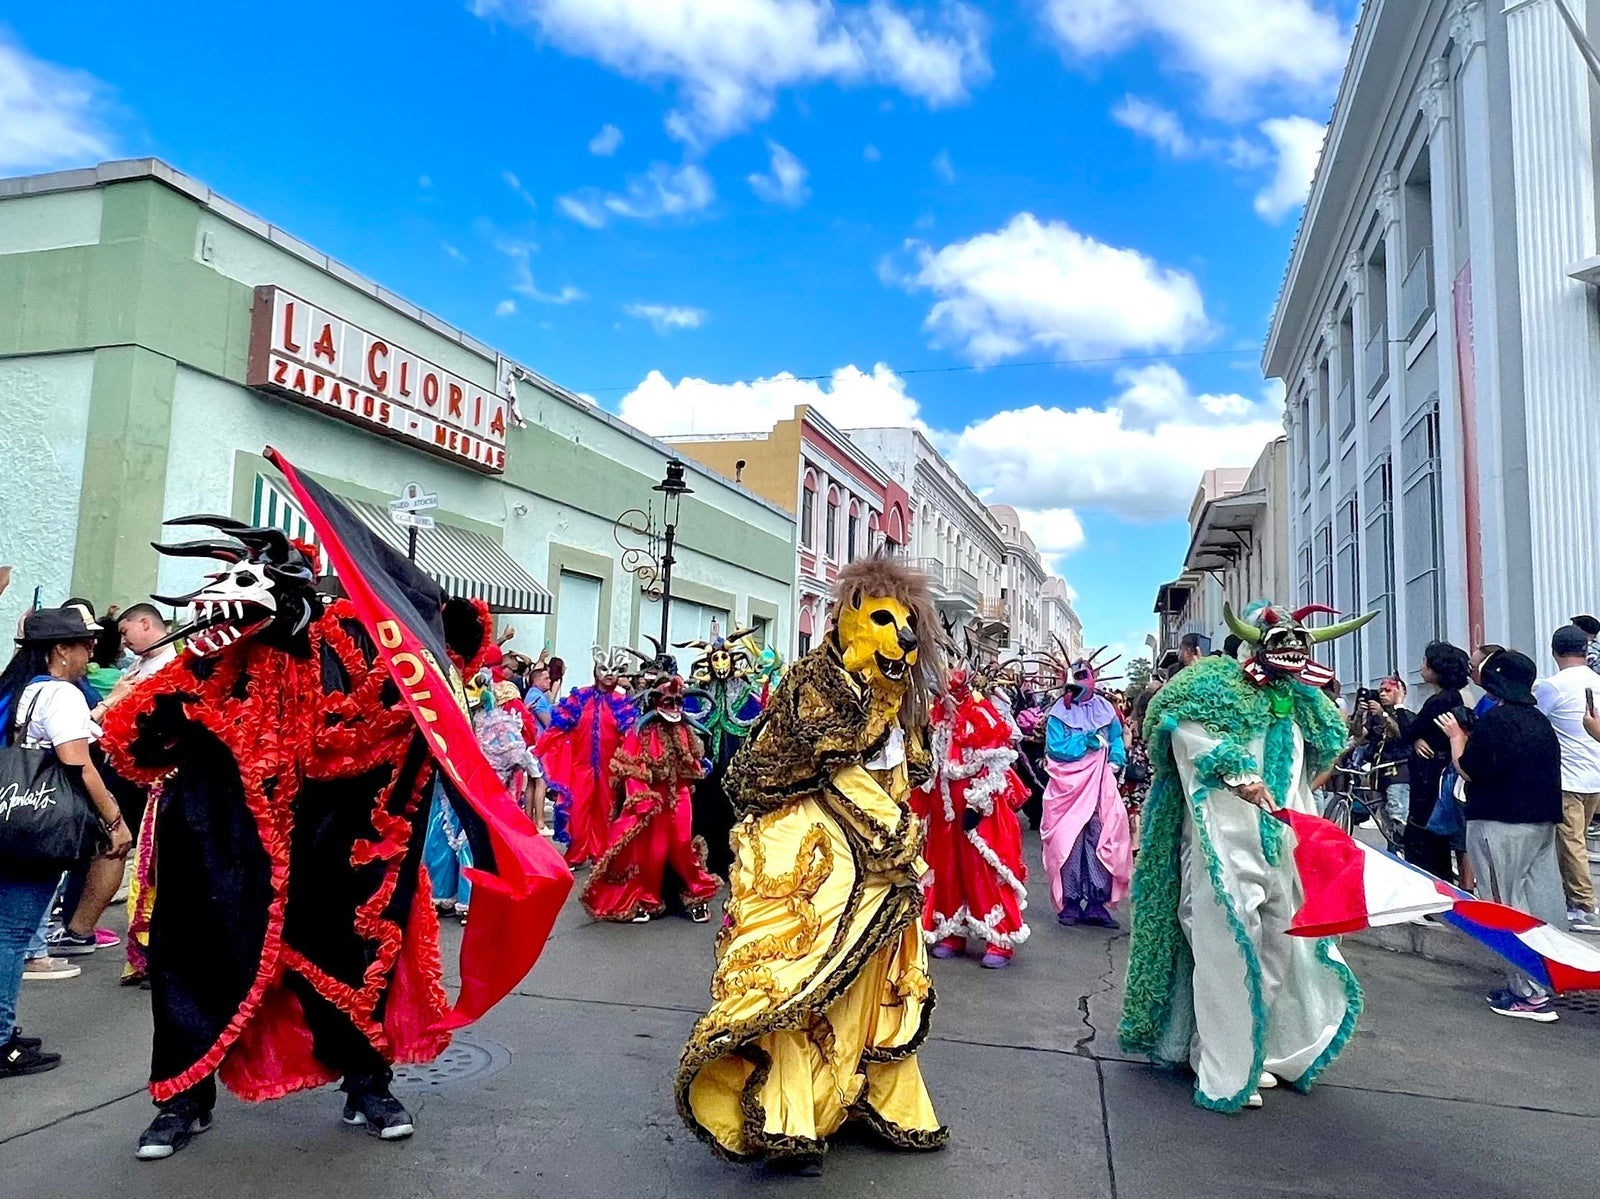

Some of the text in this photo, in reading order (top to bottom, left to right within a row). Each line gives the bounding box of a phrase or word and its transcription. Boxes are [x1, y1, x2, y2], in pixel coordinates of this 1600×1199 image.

[273, 359, 391, 423] ZAPATOS
[434, 424, 505, 469] MEDIAS
[283, 302, 506, 438] LA GLORIA
